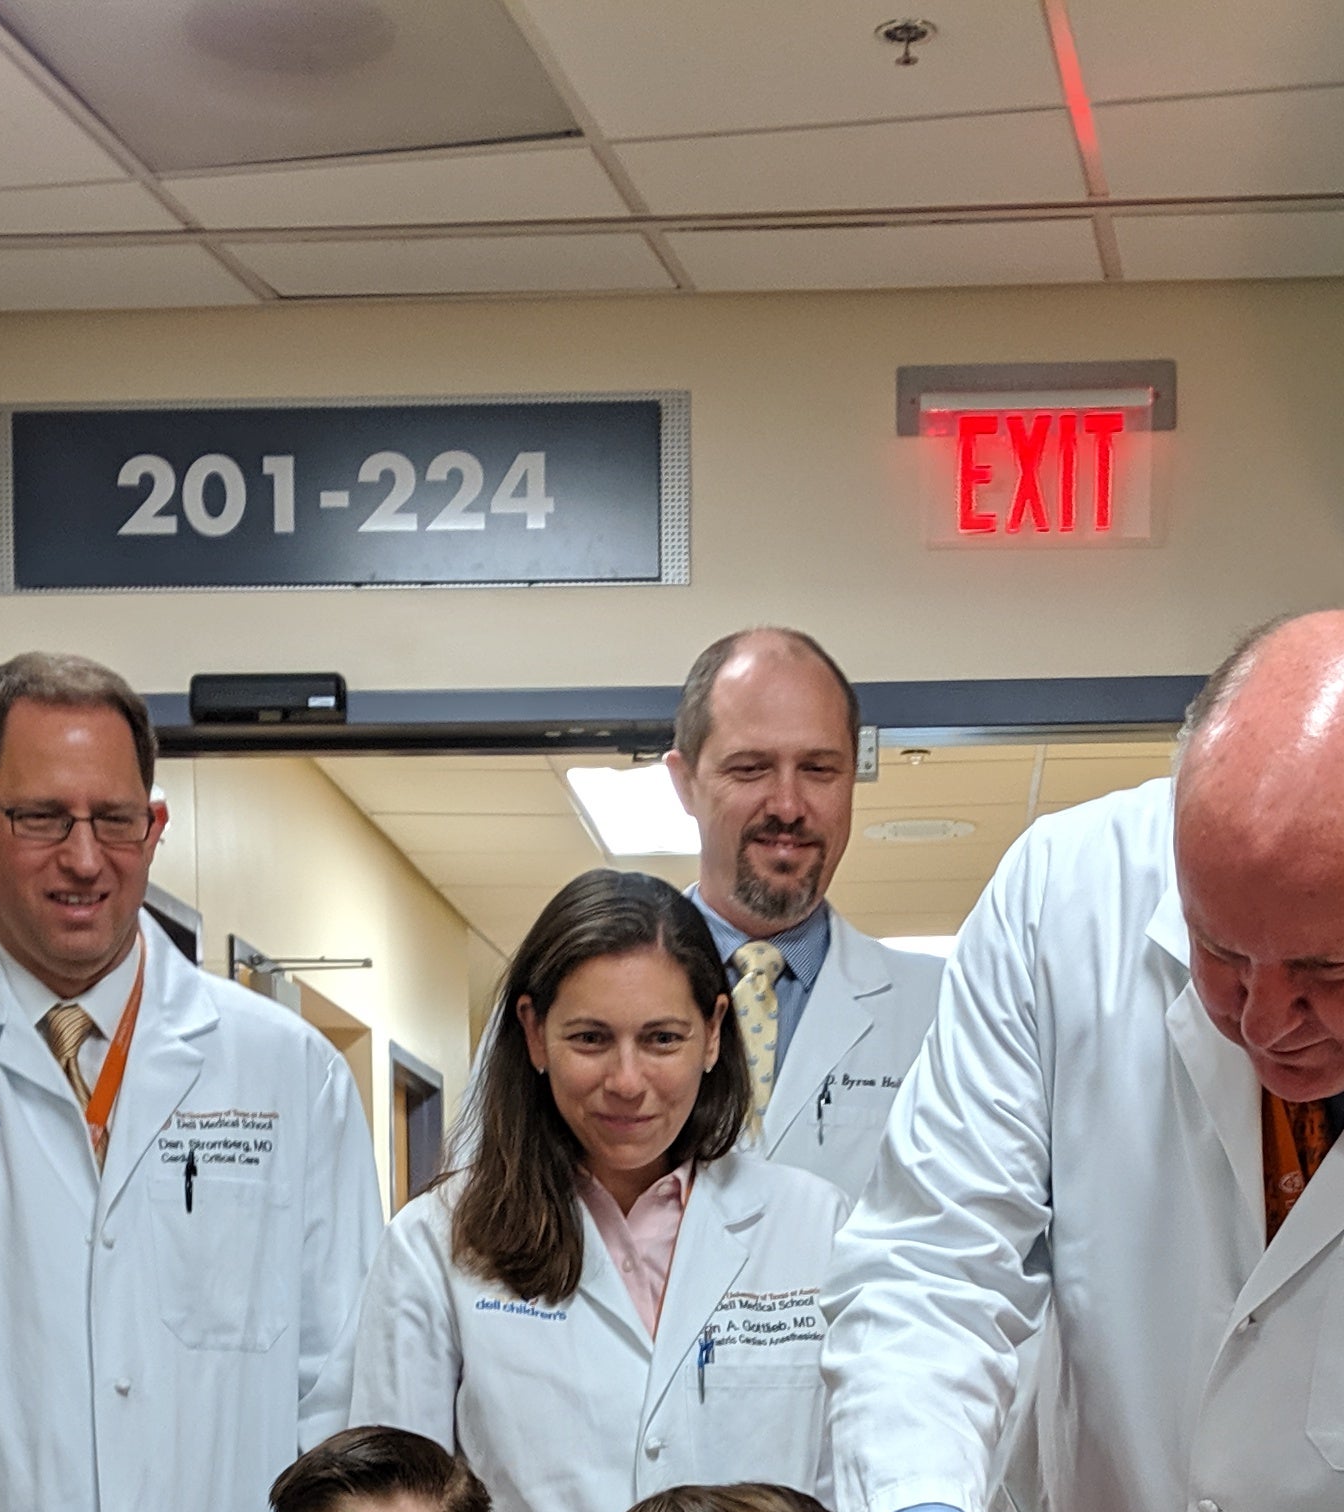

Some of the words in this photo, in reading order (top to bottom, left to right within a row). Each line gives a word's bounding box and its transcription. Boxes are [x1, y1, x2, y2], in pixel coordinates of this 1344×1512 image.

[958, 412, 1125, 534] EXIT
[116, 450, 555, 537] 201-224
[199, 1118, 239, 1130] Medical
[241, 1118, 273, 1130] School
[253, 1139, 273, 1152] MD
[476, 1299, 500, 1310] dell
[502, 1302, 567, 1321] children's
[739, 1298, 776, 1312] Medical
[778, 1295, 815, 1311] School
[793, 1316, 816, 1328] MD
